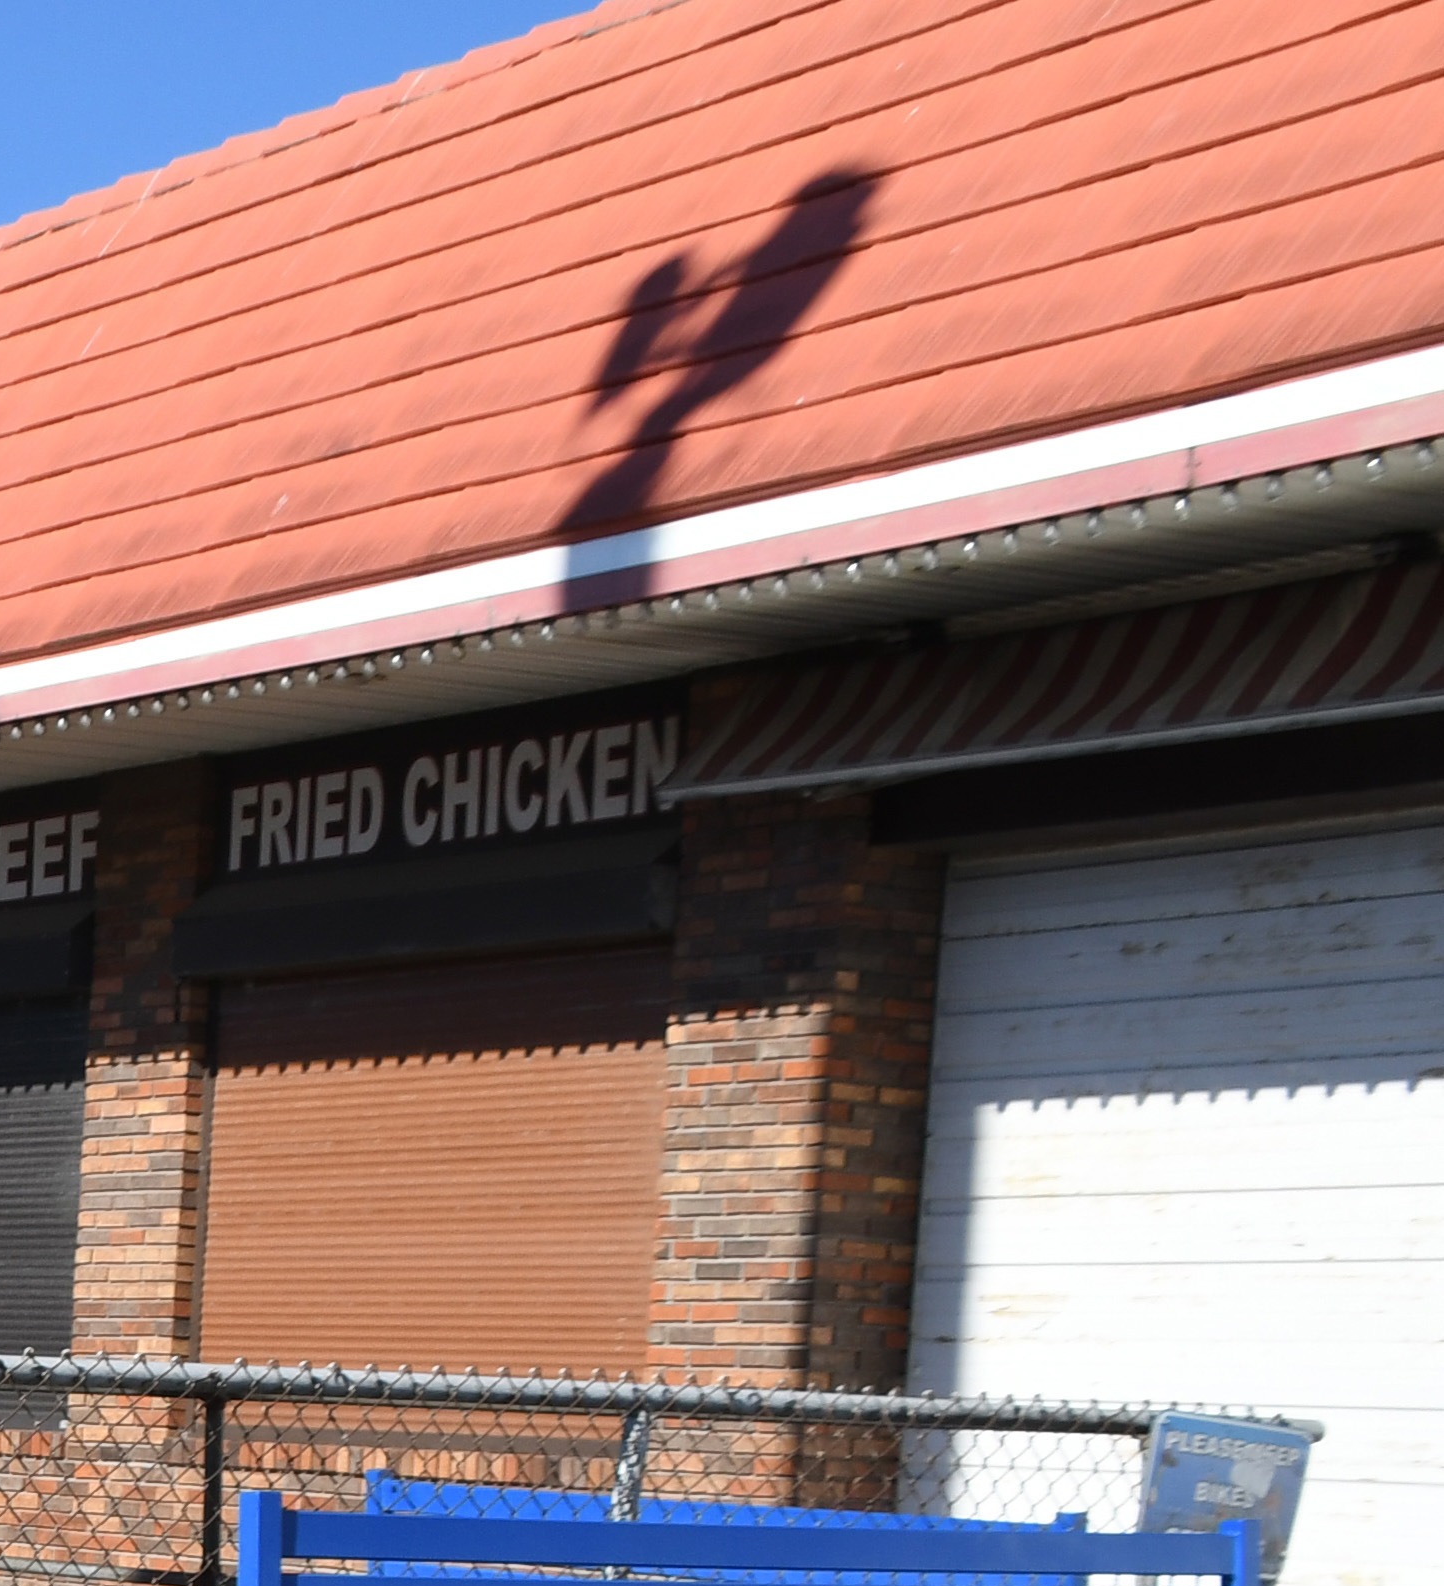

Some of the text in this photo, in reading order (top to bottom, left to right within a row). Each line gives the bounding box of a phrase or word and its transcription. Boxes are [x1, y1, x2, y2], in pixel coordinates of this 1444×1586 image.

[227, 714, 680, 872] FRIED CHICKEN
[1164, 1430, 1247, 1460] PLEASE
